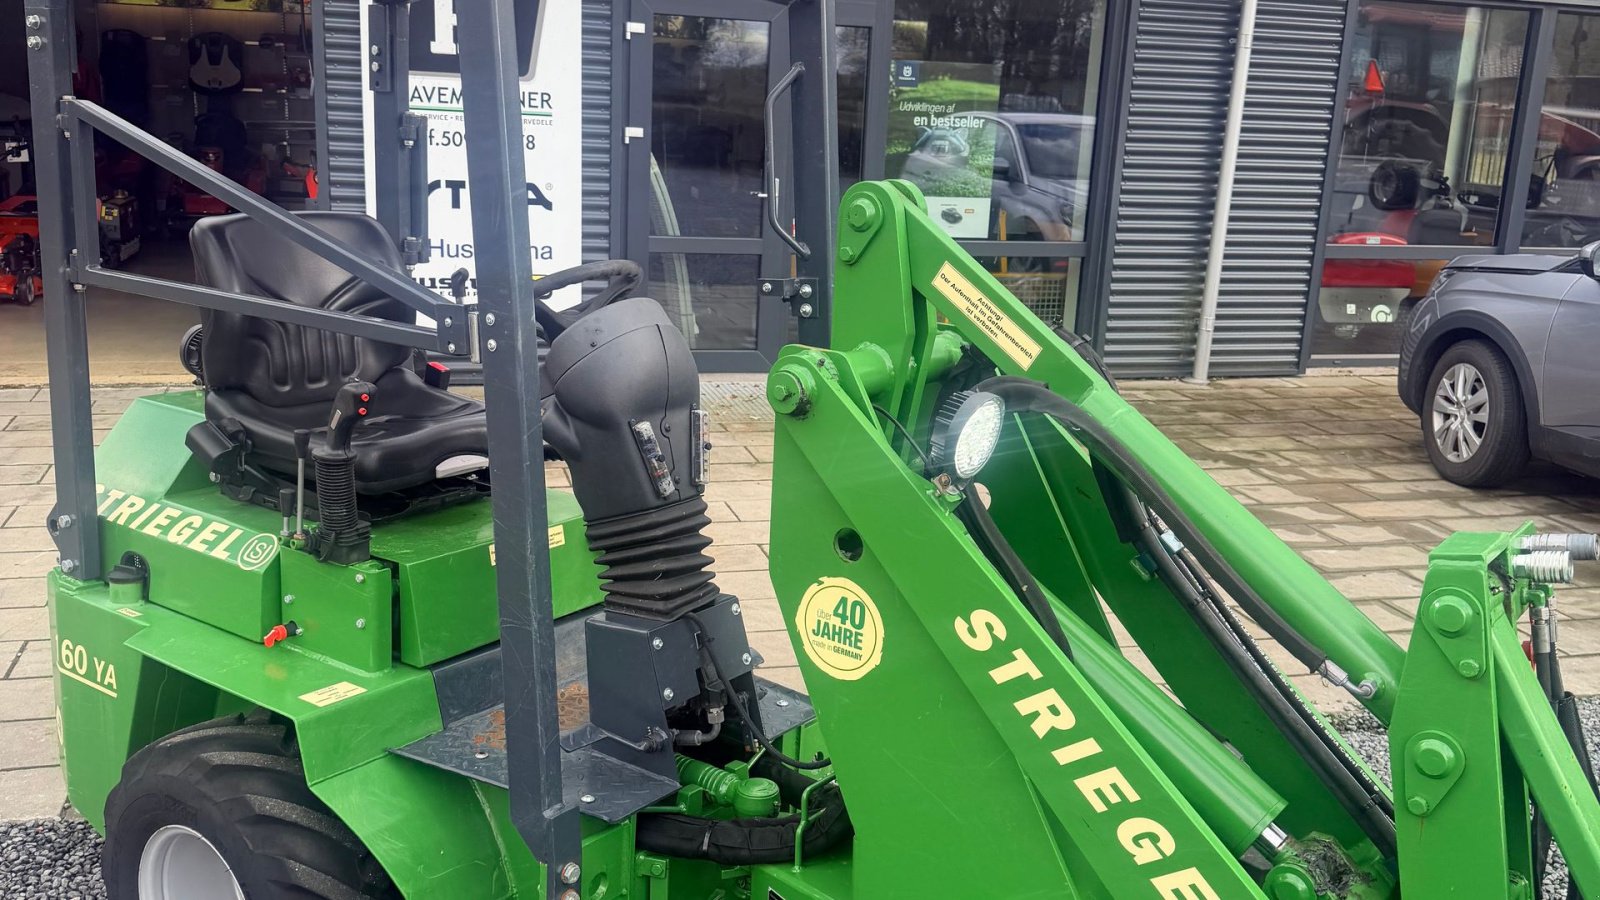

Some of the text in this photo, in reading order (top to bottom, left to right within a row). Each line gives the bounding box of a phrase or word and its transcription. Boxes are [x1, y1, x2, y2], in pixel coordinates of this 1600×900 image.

[899, 101, 956, 114] Udviklingen af
[913, 114, 986, 129] en bestseller
[940, 272, 1033, 360] Der Aufenthalt im Gefahrenbereich
[965, 306, 974, 316] ist
[977, 297, 1004, 322] Achtung!
[96, 483, 244, 560] TRIEGEL
[833, 595, 866, 631] 40
[811, 619, 864, 651] JAHRE
[811, 639, 827, 649] made
[833, 645, 863, 662] GERMANY
[93, 656, 117, 690] YA
[954, 609, 1222, 900] STRIEGE
